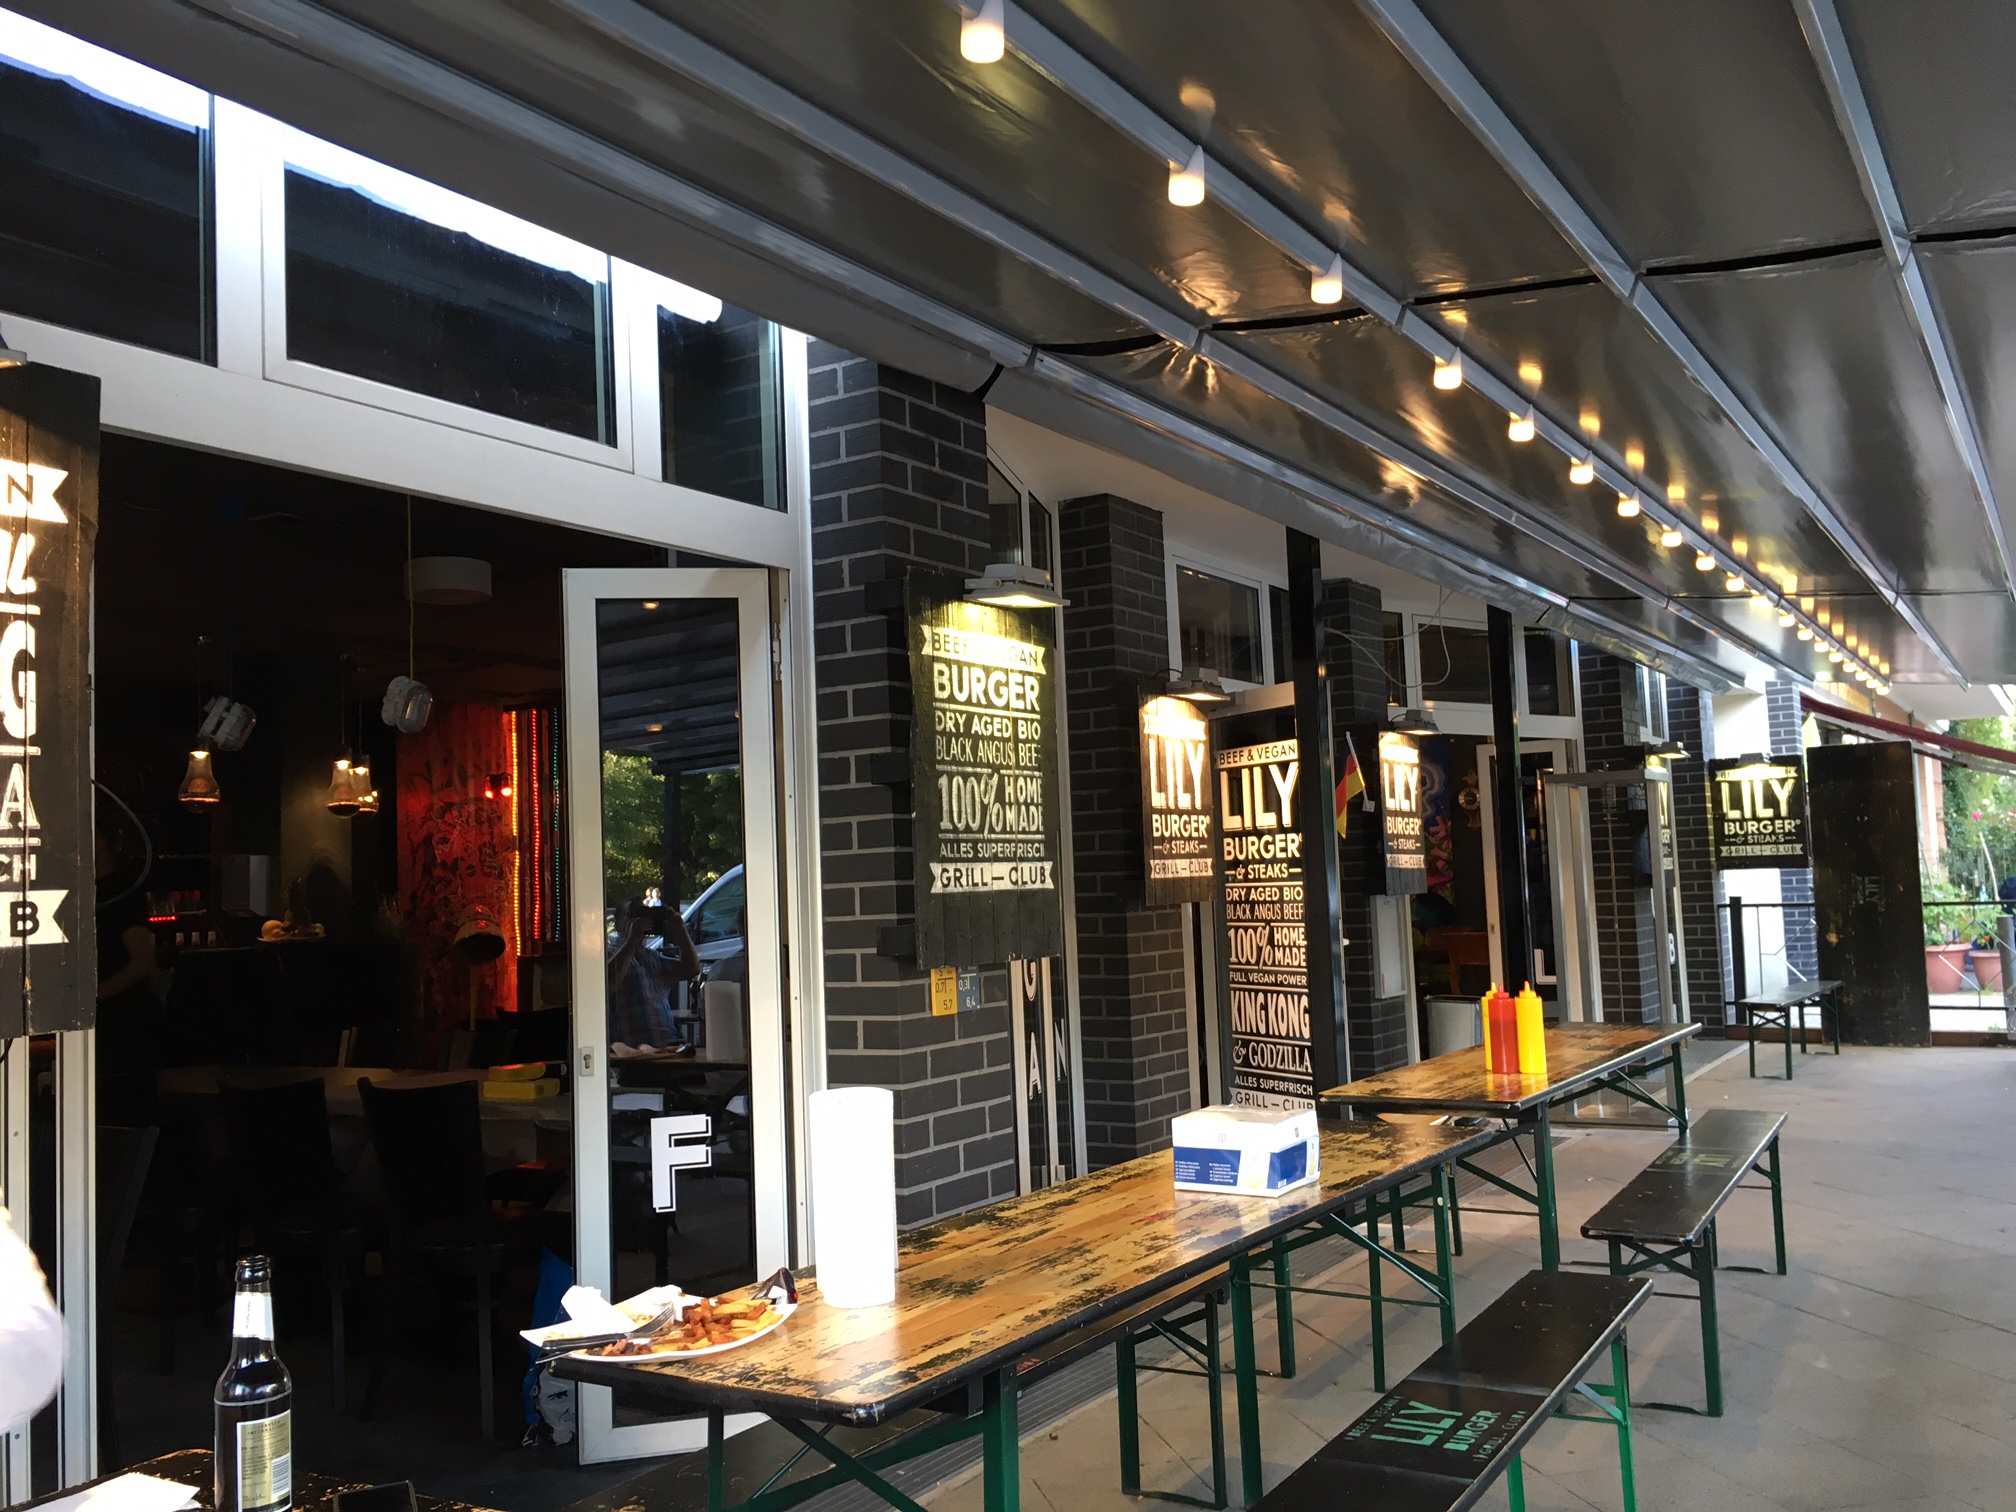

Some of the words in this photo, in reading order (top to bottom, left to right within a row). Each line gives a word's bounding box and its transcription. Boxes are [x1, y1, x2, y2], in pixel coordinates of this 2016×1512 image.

[933, 661, 1041, 712] BURGER
[934, 710, 967, 734] DRY
[971, 714, 1012, 738] AGED
[1018, 719, 1041, 741] BIO
[935, 735, 974, 764] BLACK
[976, 739, 1014, 766] ANGUS
[1219, 750, 1244, 766] BEEF
[1247, 748, 1254, 762] &
[1256, 743, 1296, 760] VEGAN
[1148, 737, 1205, 810] LILY
[1220, 761, 1299, 832] LILY
[1383, 762, 1419, 813] LILY
[1720, 778, 1796, 820] LILY
[938, 771, 1004, 840] 100%
[1005, 804, 1044, 832] MADE
[939, 842, 974, 859] ALLES
[1171, 839, 1200, 854] STEAKS
[1398, 838, 1416, 850] STEAKS
[1725, 845, 1757, 855] GRILL
[1769, 845, 1798, 855] CLUB
[1747, 833, 1785, 844] STEAKS
[940, 867, 988, 889] GRILL
[1008, 865, 1047, 886] CLUB
[1154, 859, 1179, 876] GRILL
[1189, 860, 1209, 874] CLUB
[1247, 863, 1289, 880] STEAKS
[1225, 887, 1247, 901] DRY
[1249, 887, 1280, 901] AGED
[1283, 886, 1304, 901] BIO
[1226, 903, 1252, 920] BLACK
[1253, 903, 1282, 920] ANGUS
[1284, 902, 1304, 920] BEEF
[1227, 924, 1273, 970] 100%
[1273, 926, 1305, 947] HOME
[1274, 946, 1307, 967] MADE
[1229, 971, 1247, 983] FULL
[1249, 972, 1275, 984] VEGAN
[1277, 973, 1307, 986] POWER
[1230, 989, 1266, 1035] KING
[1267, 992, 1310, 1040] KONG
[1249, 1041, 1313, 1074] GODZILLA
[1234, 1074, 1257, 1088] ALLES
[1259, 1077, 1314, 1096] SUPERFRISCH
[1235, 1091, 1268, 1109] GRILL
[651, 1113, 712, 1213] F
[1370, 1400, 1464, 1447] LILY
[1442, 1409, 1502, 1451] BURGER
